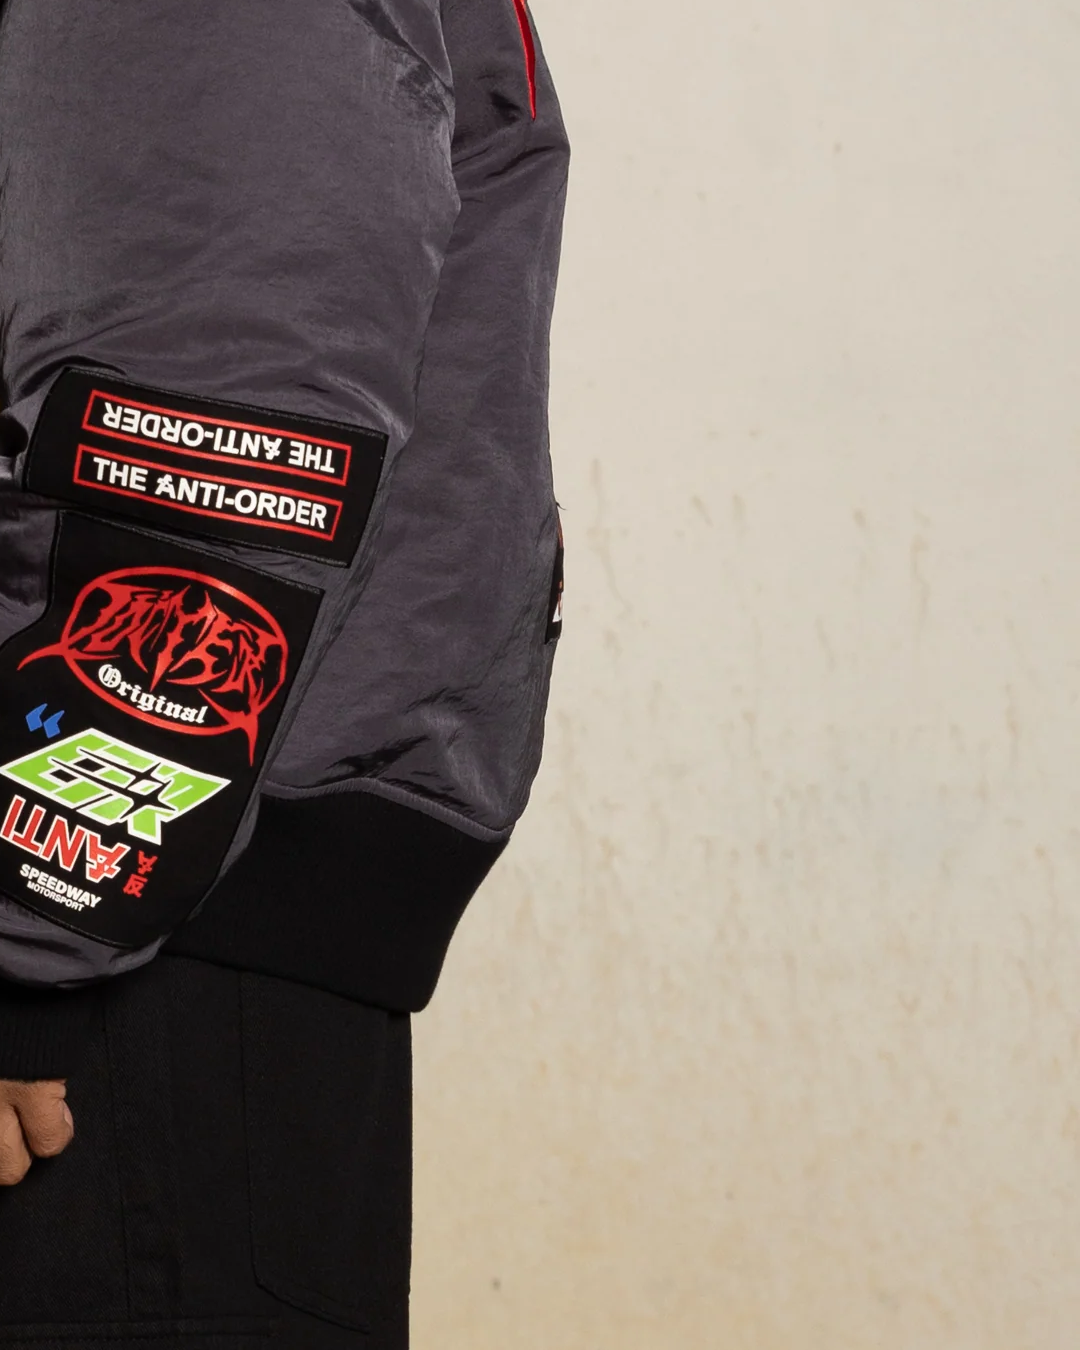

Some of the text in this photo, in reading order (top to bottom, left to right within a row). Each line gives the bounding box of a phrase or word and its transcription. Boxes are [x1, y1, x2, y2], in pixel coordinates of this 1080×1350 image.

[102, 401, 336, 474] THE ANTI-ORDER
[92, 456, 328, 529] THE ANTI-ORDER
[97, 663, 209, 725] Original
[0, 794, 132, 884] ANTI
[19, 863, 103, 908] SPEEDWAY
[26, 880, 85, 912] MOTORSPORT
